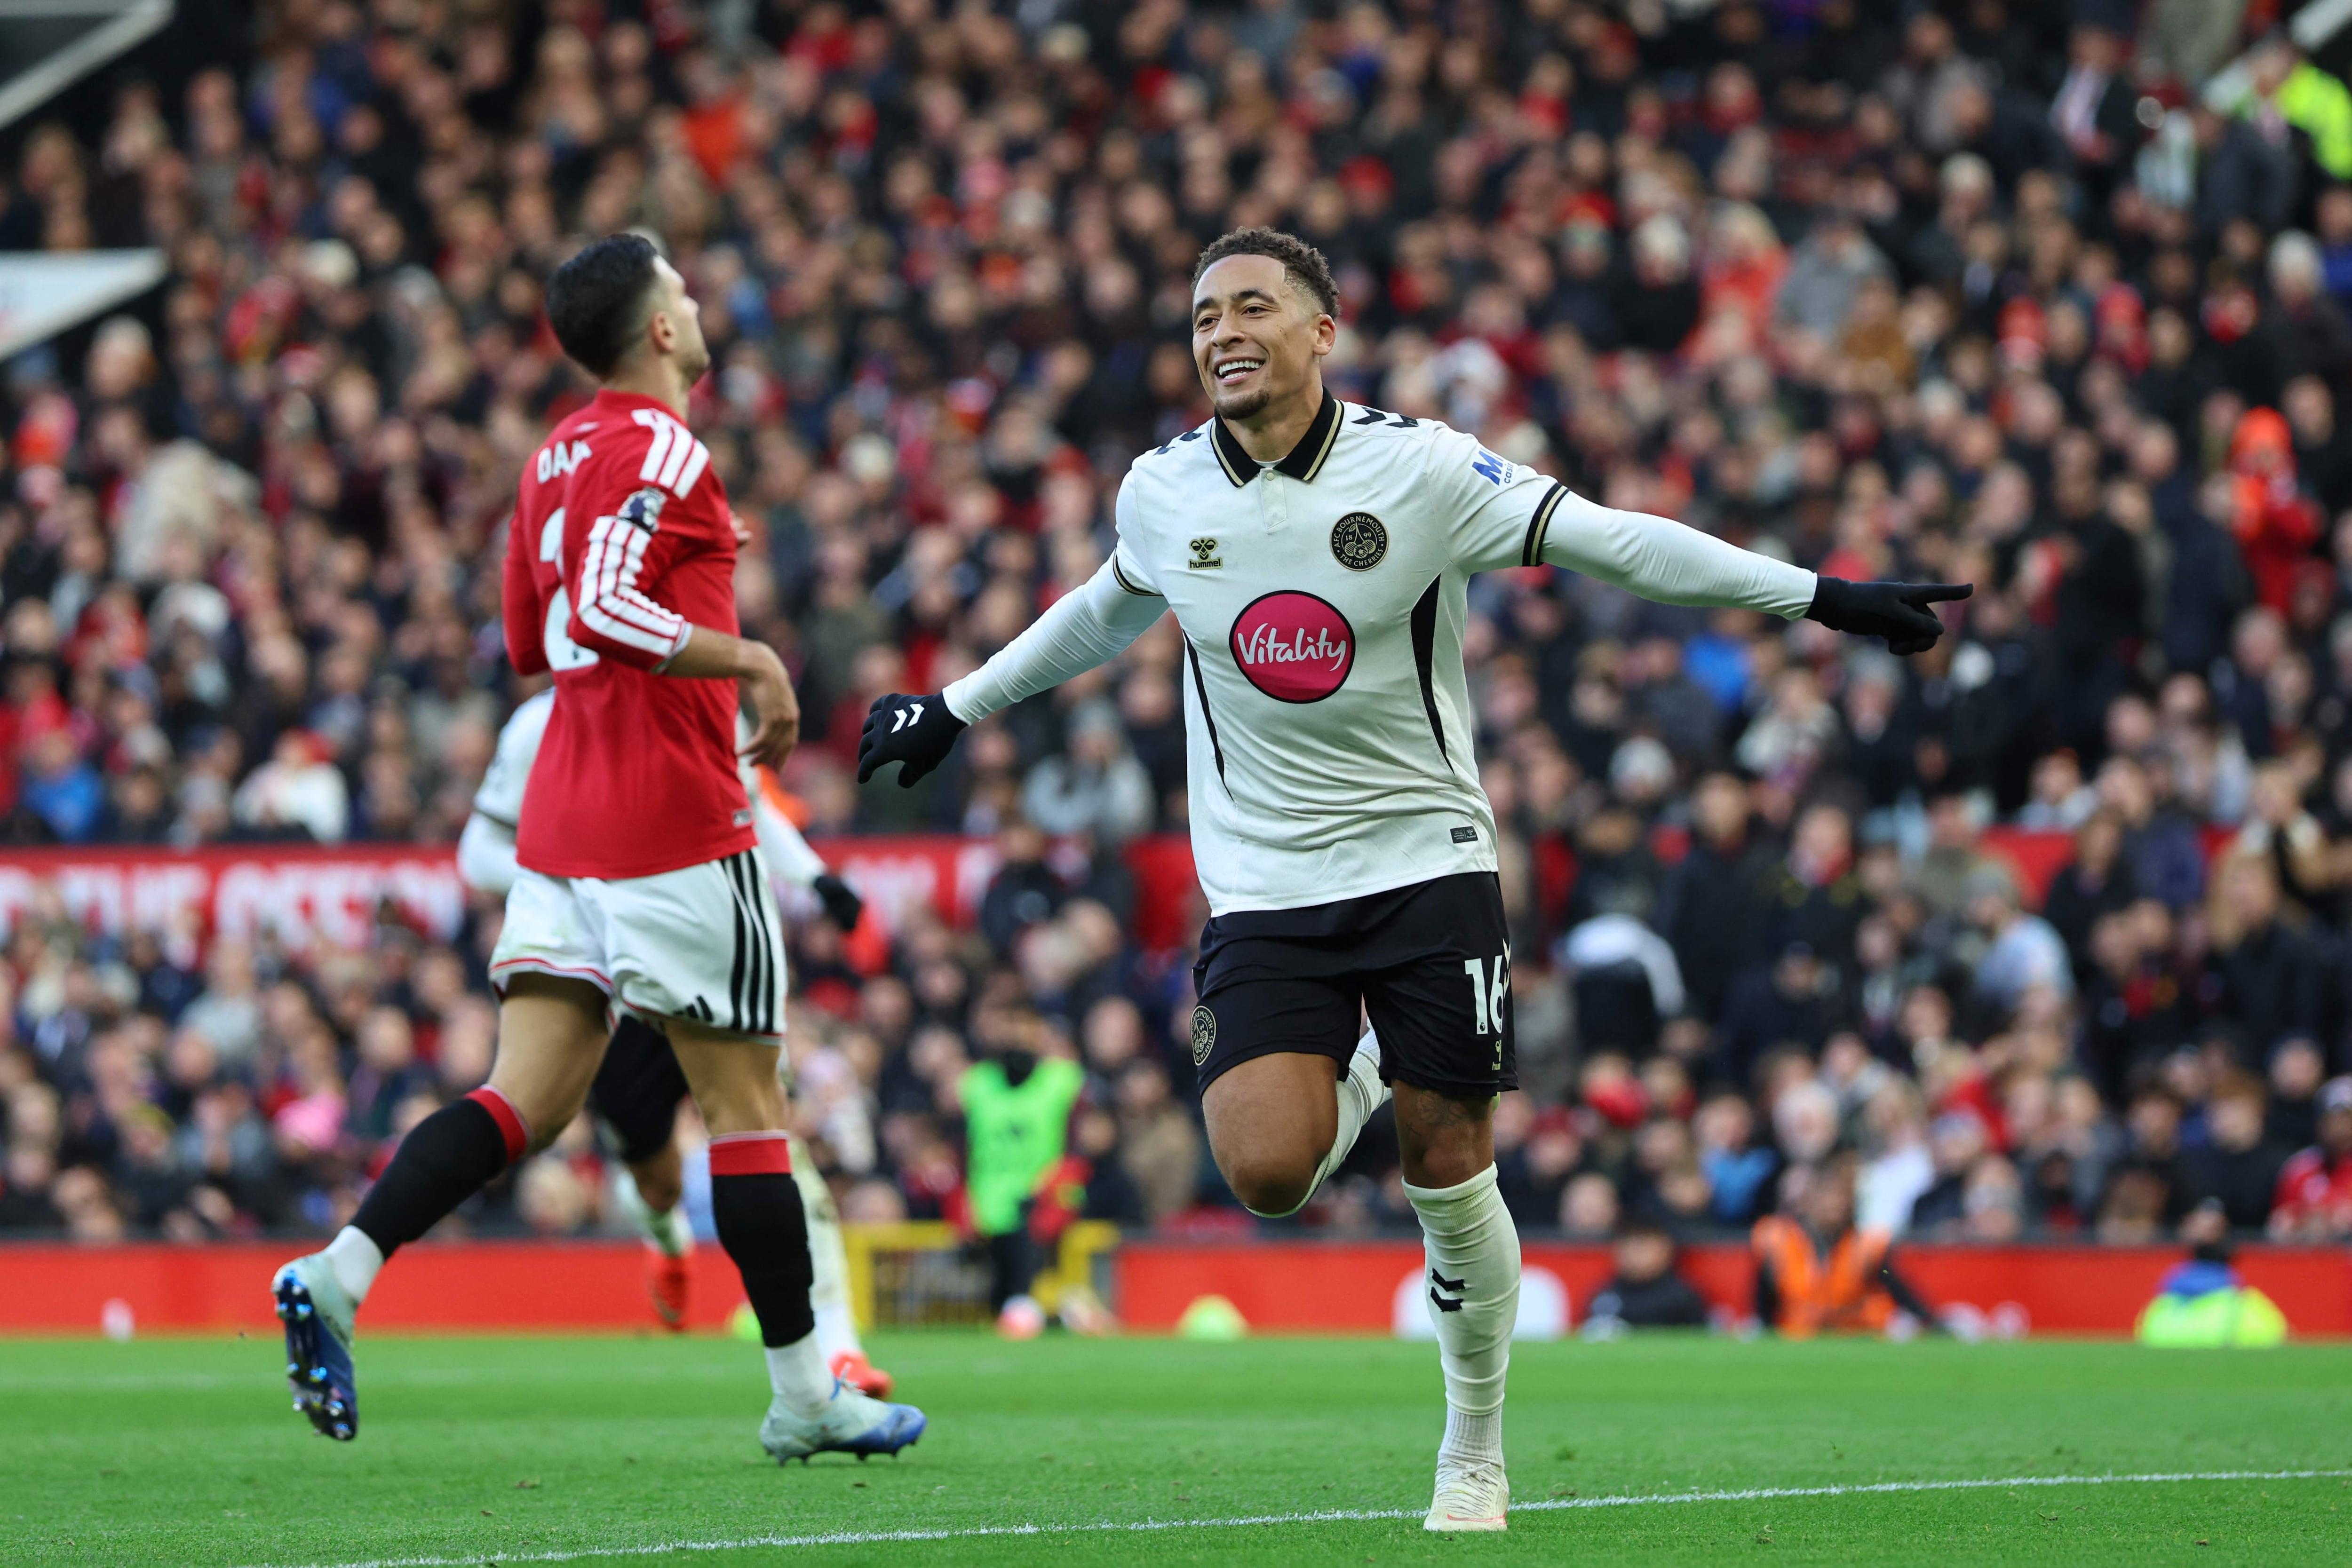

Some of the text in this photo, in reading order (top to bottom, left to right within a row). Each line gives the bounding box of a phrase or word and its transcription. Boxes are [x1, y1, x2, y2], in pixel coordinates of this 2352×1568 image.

[1336, 515, 1385, 542] BOURNEMOUTH
[1190, 558, 1221, 569] hummel
[1340, 548, 1383, 566] THE CHERRIES
[1237, 623, 1346, 672] Vitality
[1464, 955, 1503, 1035] 16
